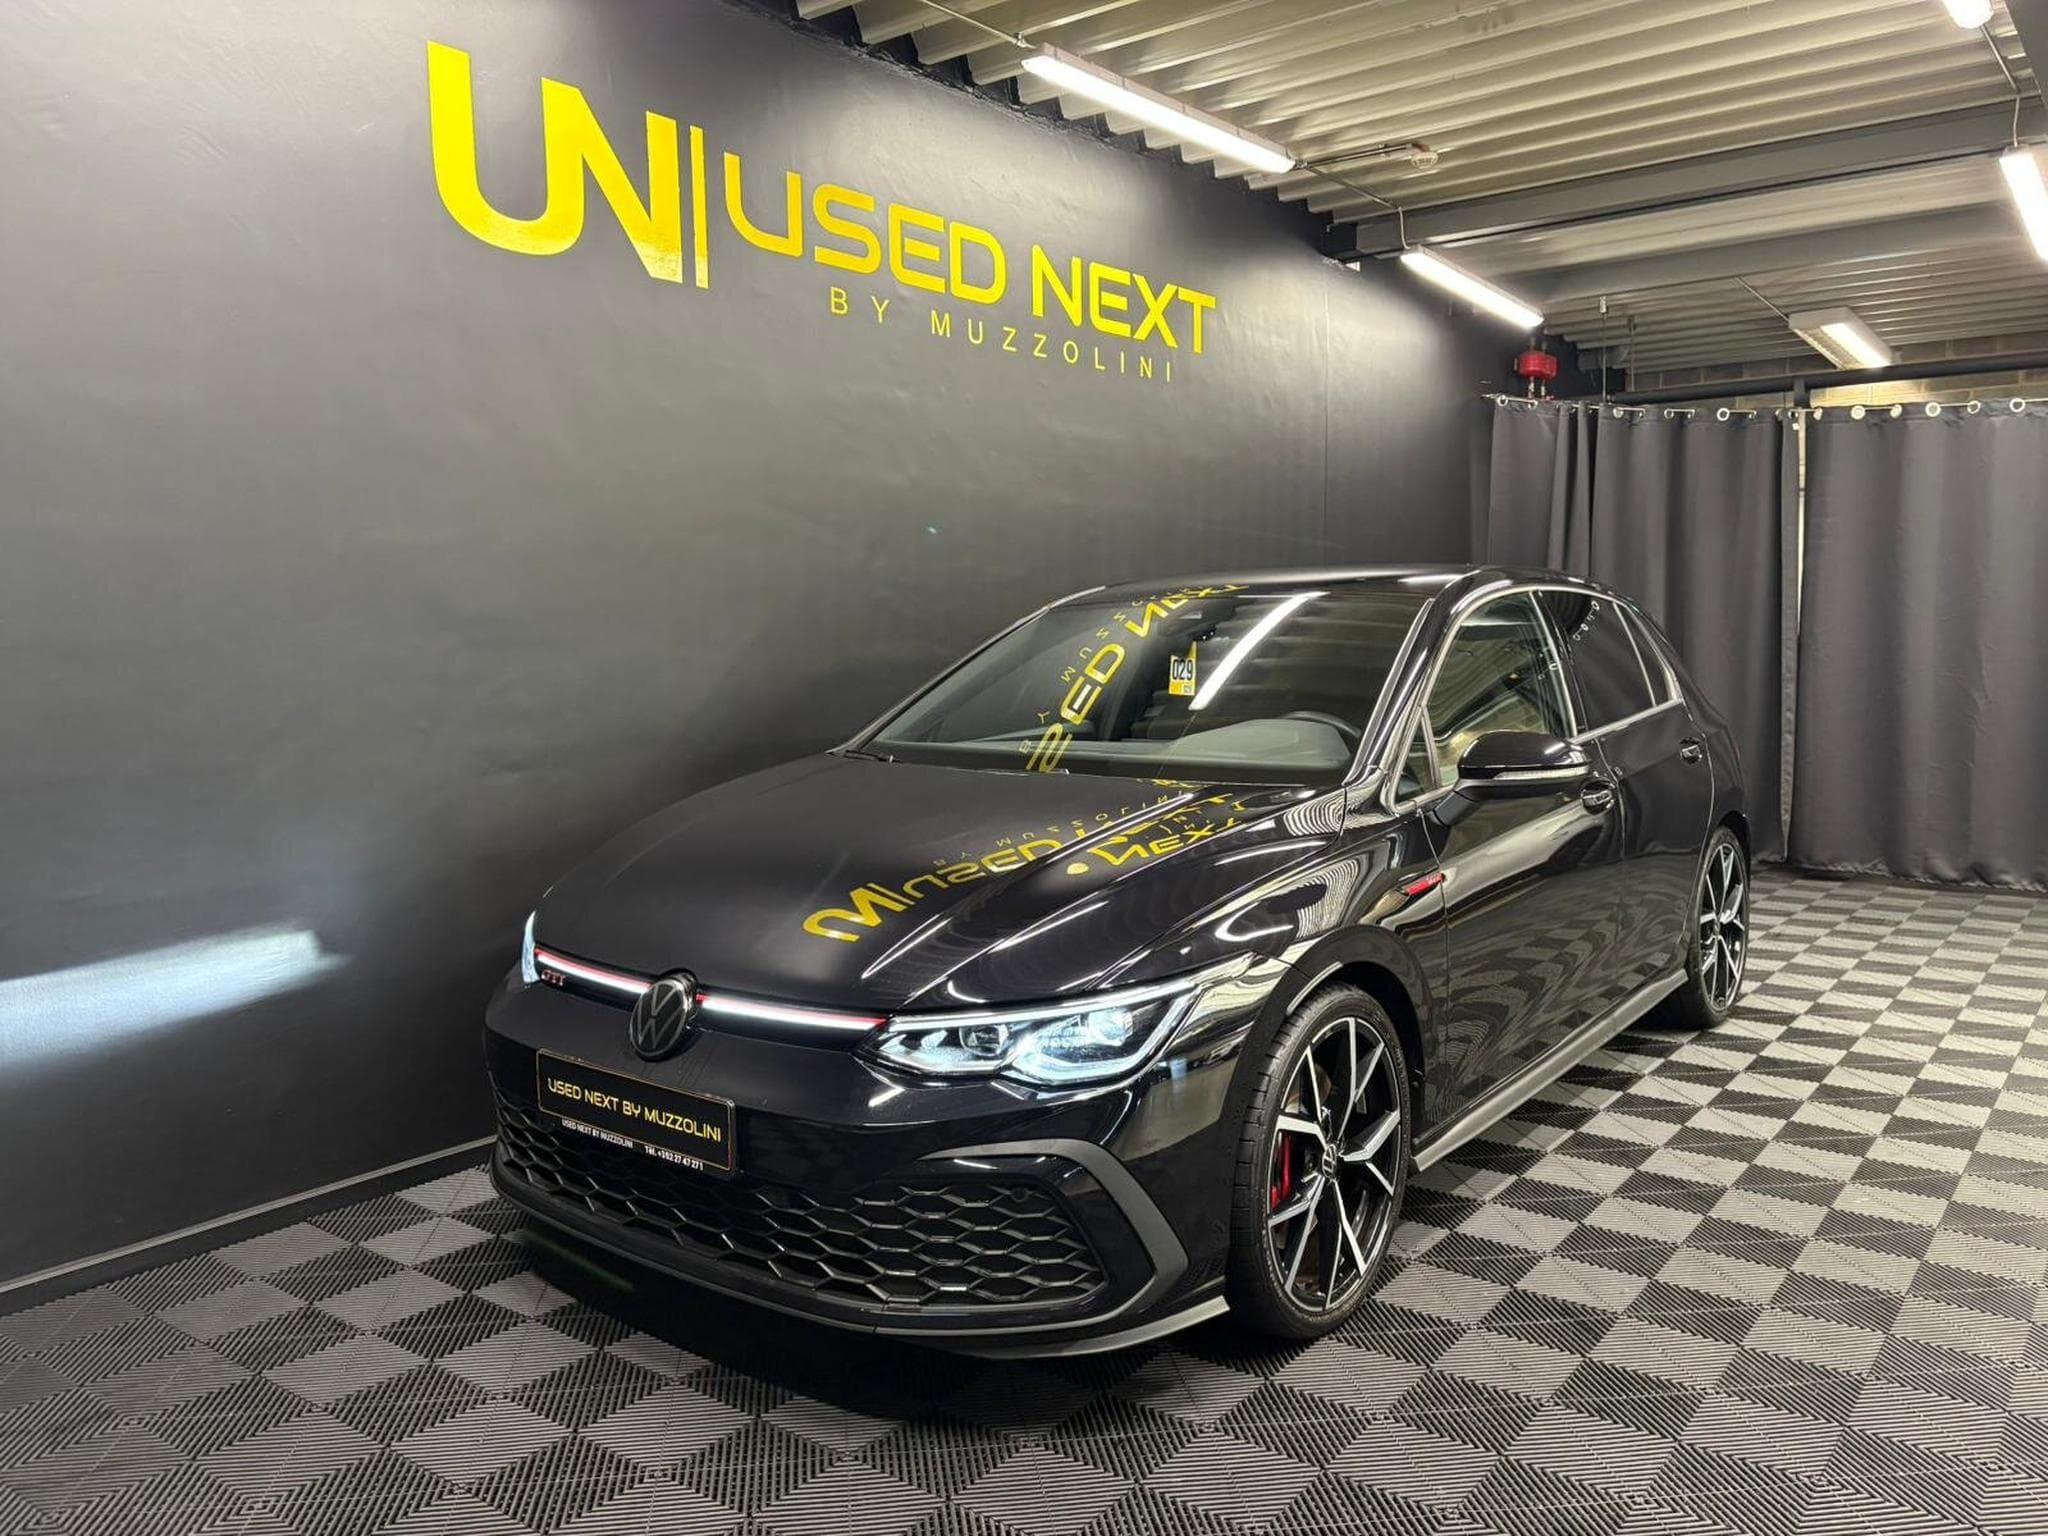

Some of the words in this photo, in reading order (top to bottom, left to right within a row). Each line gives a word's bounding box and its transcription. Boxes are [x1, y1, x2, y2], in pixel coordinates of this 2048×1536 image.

[723, 151, 1009, 306] USED
[1030, 243, 1220, 356] NEXT
[829, 286, 890, 325] BY
[930, 308, 1172, 383] MUZZOLINI
[1172, 658, 1194, 681] 029
[547, 1078, 582, 1100] USED
[584, 1089, 619, 1111] NEXT
[622, 1101, 641, 1118] BY
[644, 1107, 721, 1142] MUZZOLINI
[561, 1119, 576, 1131] USED
[577, 1124, 592, 1136] NEXT
[600, 1132, 634, 1149] MUZZOLINI
